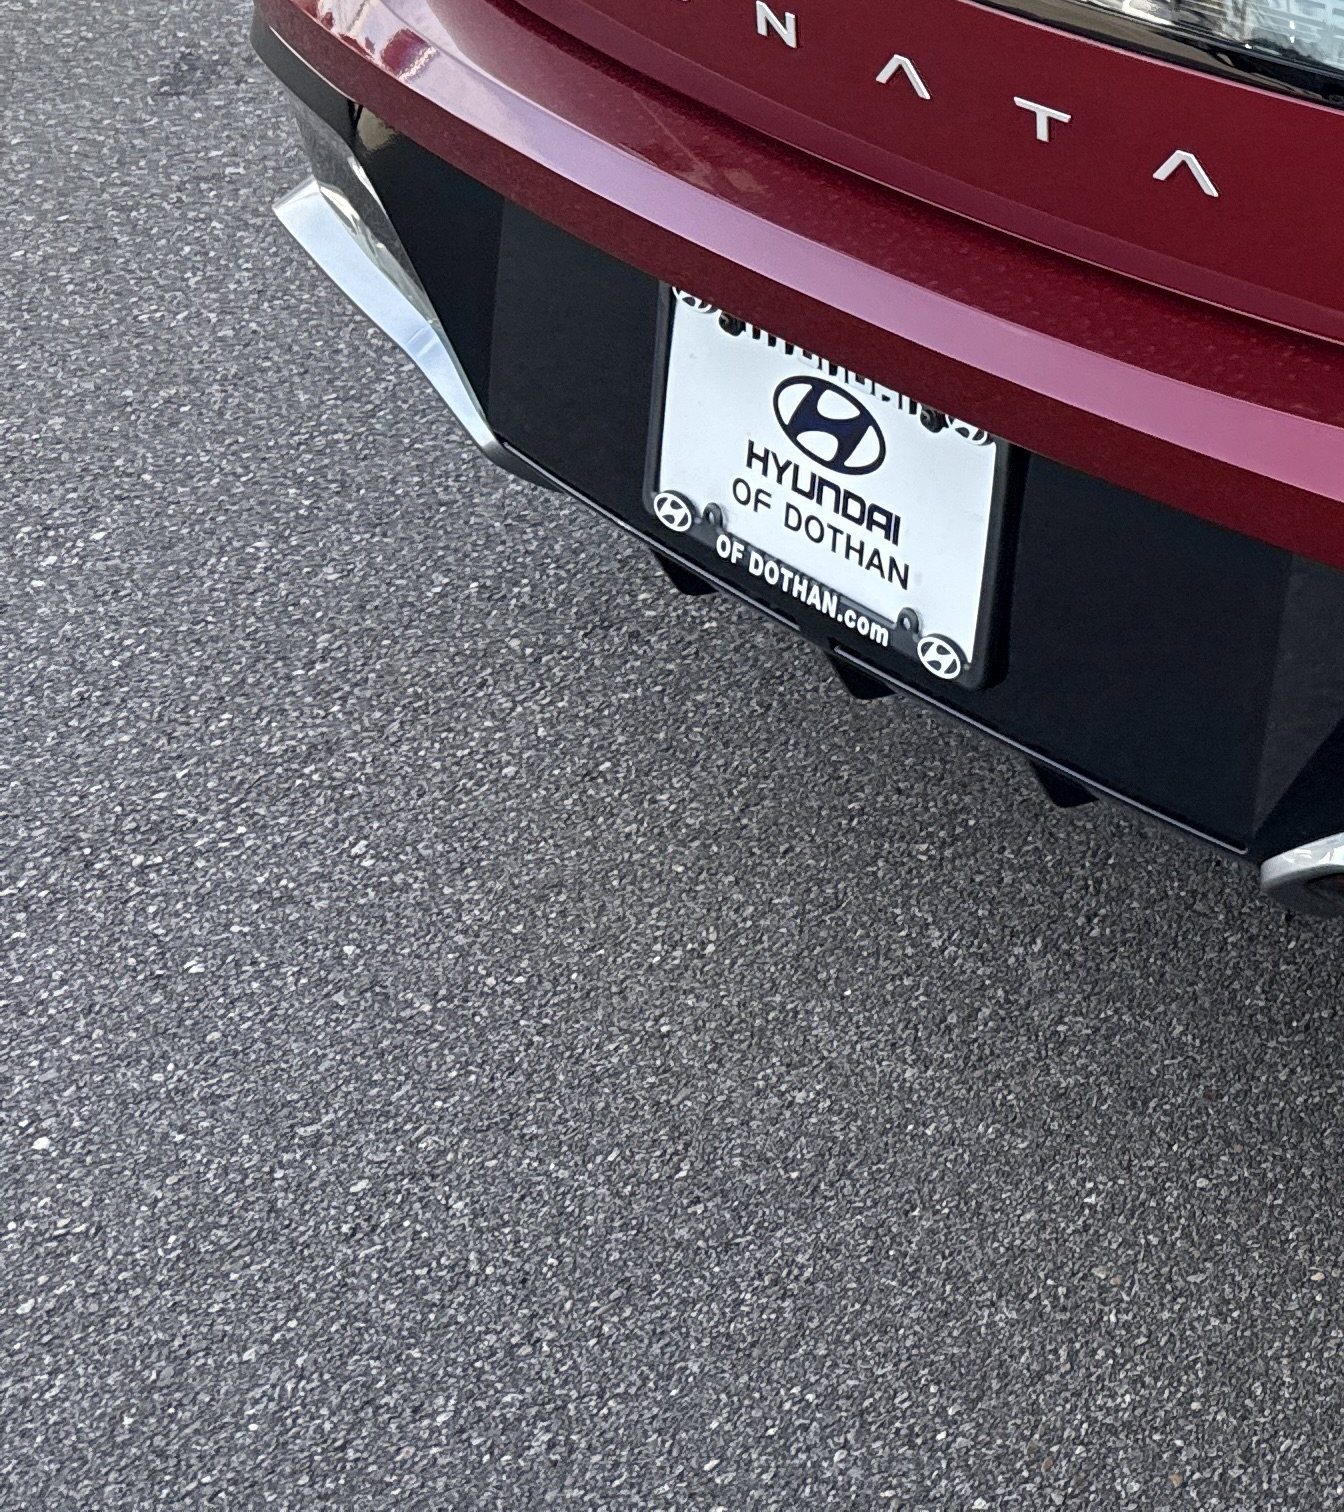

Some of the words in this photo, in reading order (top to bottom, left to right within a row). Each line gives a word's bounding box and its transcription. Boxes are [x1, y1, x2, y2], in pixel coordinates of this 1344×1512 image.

[732, 477, 772, 514] OF
[784, 501, 910, 591] DOTHAN
[746, 440, 902, 546] HYUNDAI
[715, 533, 745, 564] OF
[748, 551, 889, 647] DOTHAN.com
